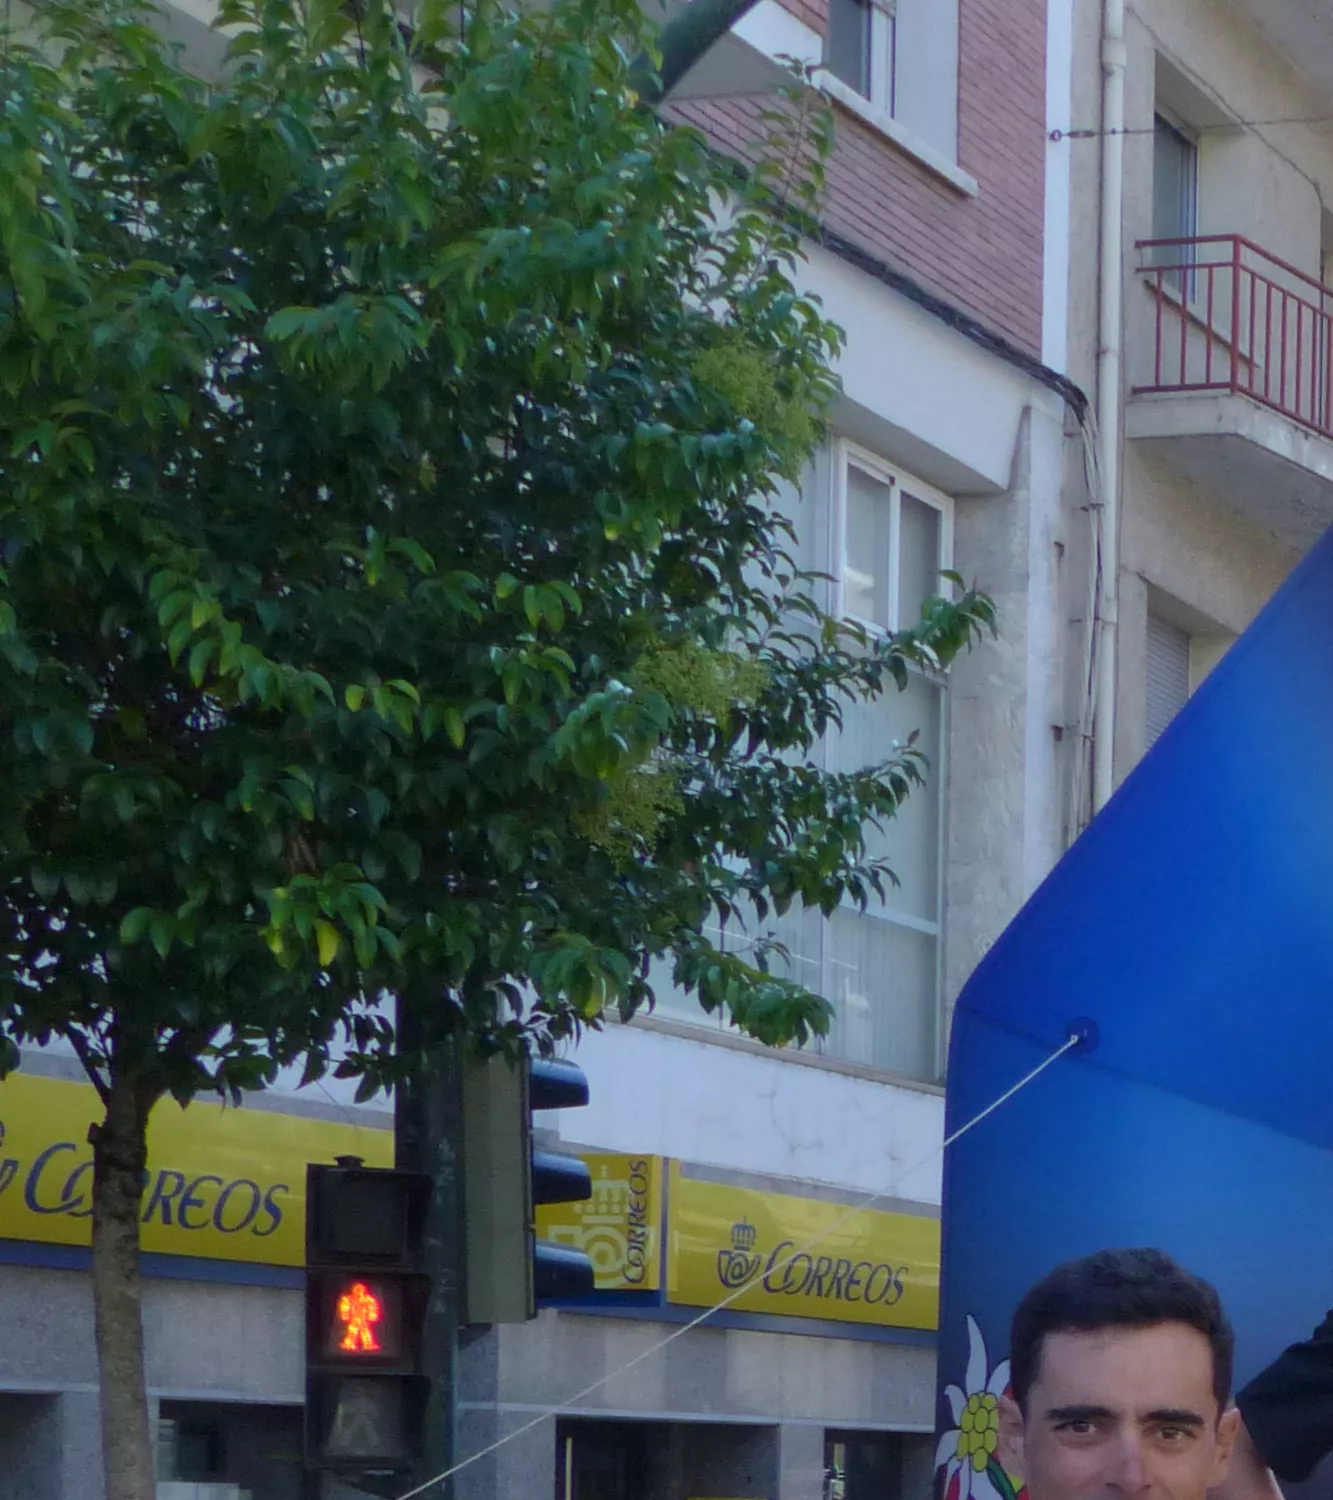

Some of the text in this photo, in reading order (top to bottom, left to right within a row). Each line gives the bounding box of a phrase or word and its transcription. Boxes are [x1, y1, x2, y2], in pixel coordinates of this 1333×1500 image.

[25, 1142, 290, 1236] COREOS
[622, 1159, 651, 1284] CORREOS
[762, 1241, 909, 1306] CORREOS
